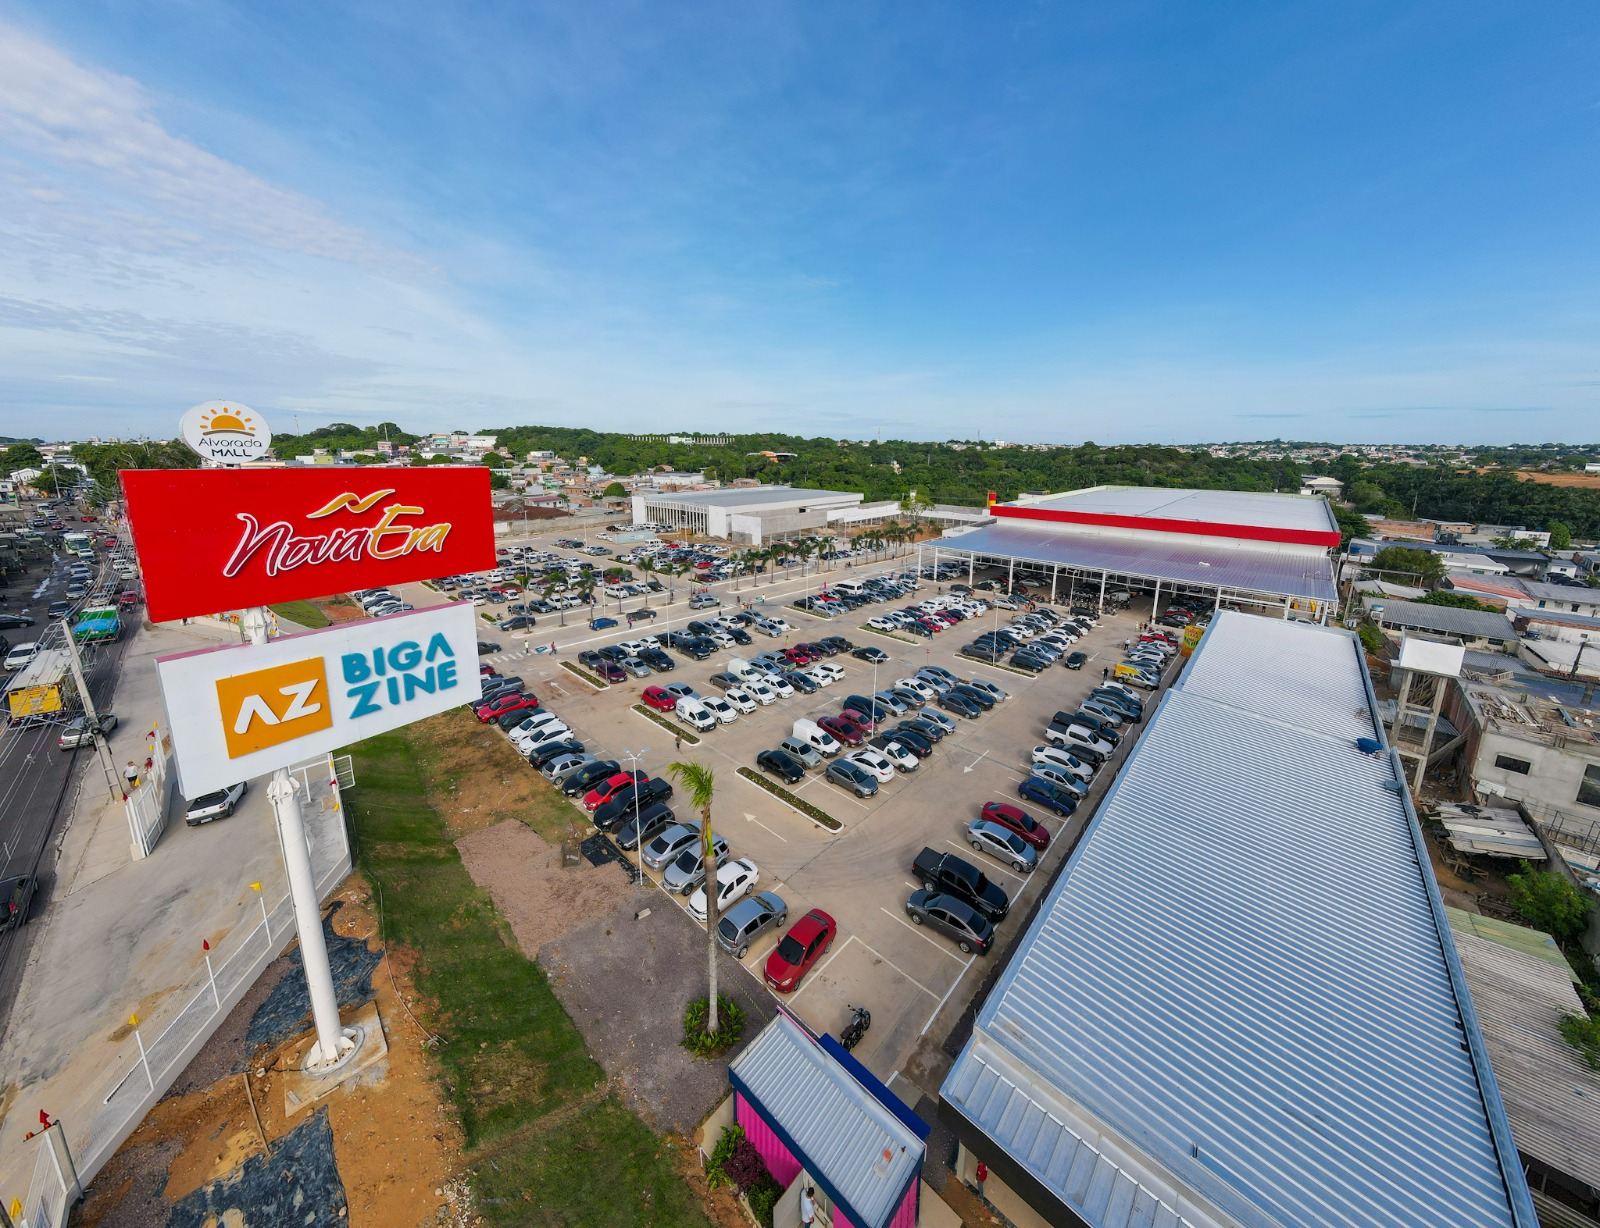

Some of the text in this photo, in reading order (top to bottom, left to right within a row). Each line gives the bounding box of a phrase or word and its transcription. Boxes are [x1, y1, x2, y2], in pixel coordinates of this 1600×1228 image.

[198, 438, 262, 447] Alvorada
[211, 449, 252, 457] MALL
[341, 632, 455, 684] BIGA
[233, 678, 321, 735] AZ
[346, 660, 458, 719] ZINE
